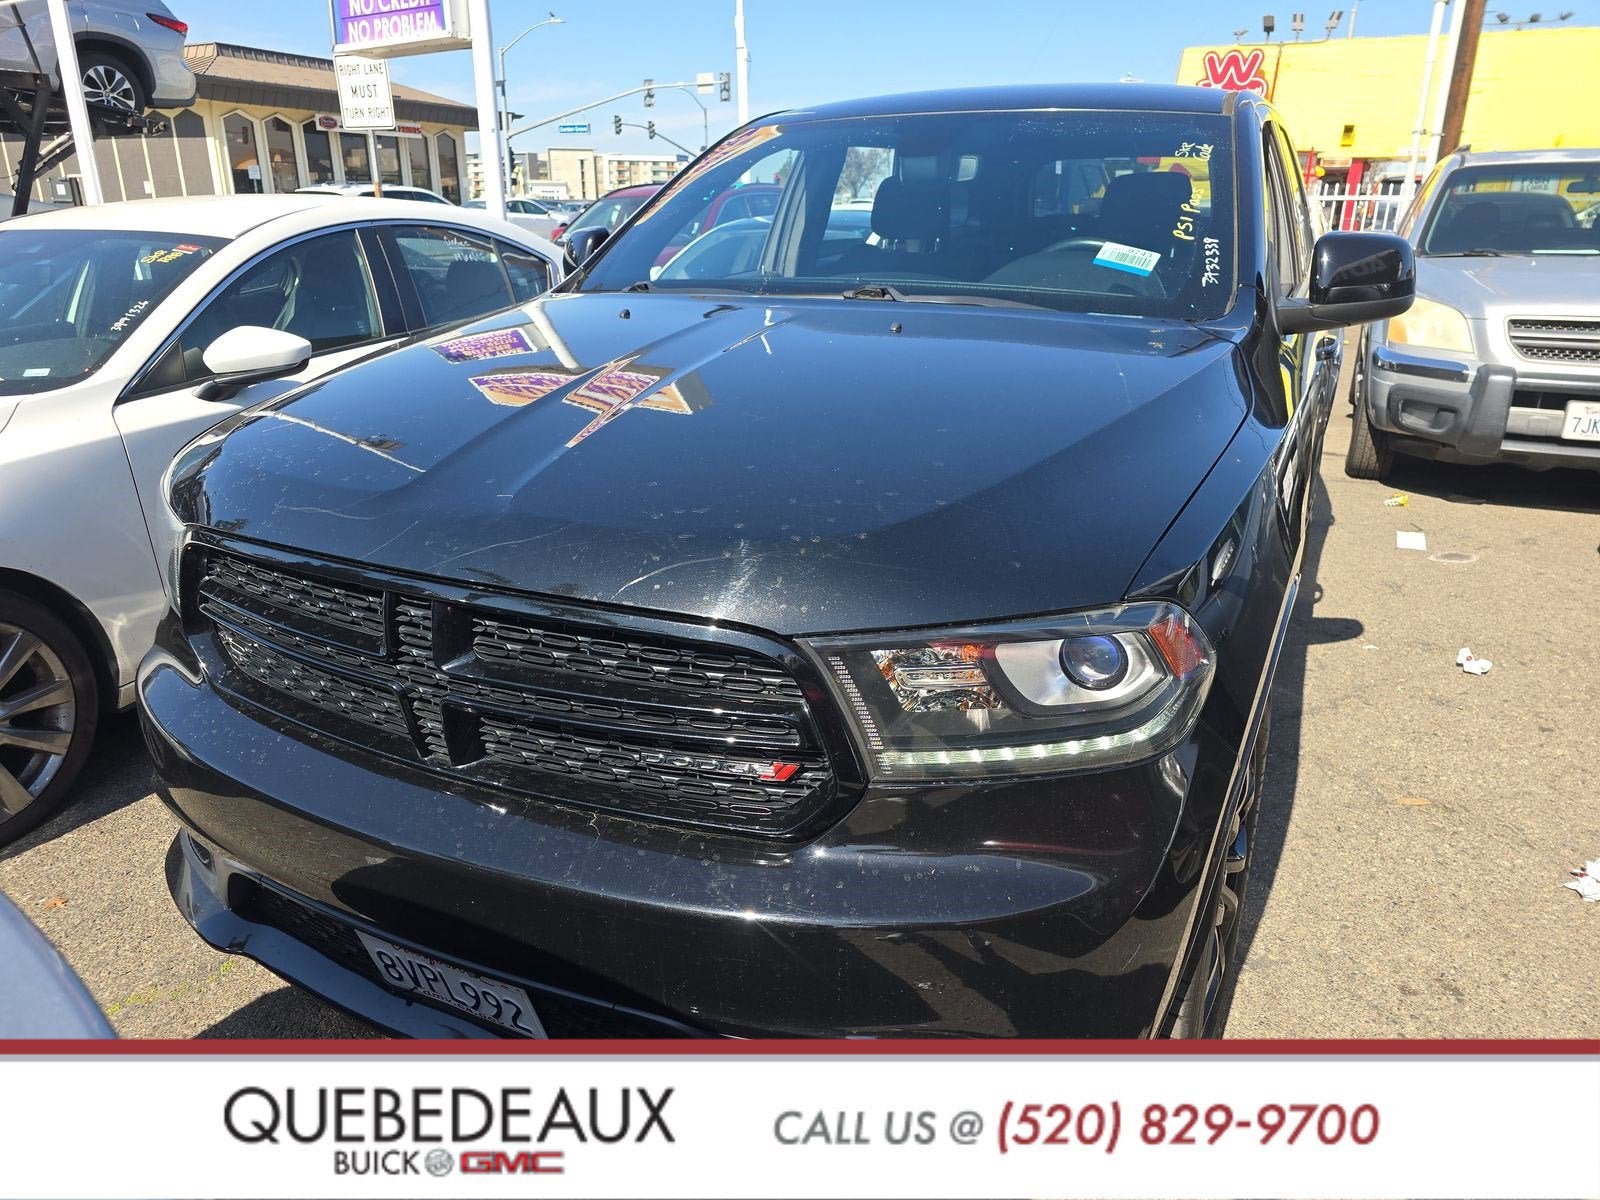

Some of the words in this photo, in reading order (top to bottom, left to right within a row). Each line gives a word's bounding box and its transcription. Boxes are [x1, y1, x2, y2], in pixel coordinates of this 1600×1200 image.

[349, 0, 375, 17] NO
[378, 0, 431, 12] CRE
[347, 19, 371, 43] NO
[373, 10, 437, 41] PROBLEM
[338, 63, 360, 76] RIGHT
[363, 62, 384, 76] LANE
[350, 84, 377, 98] MUST
[345, 107, 365, 119] TURN
[367, 106, 390, 119] RIGHT
[376, 950, 533, 1035] 8VPL992
